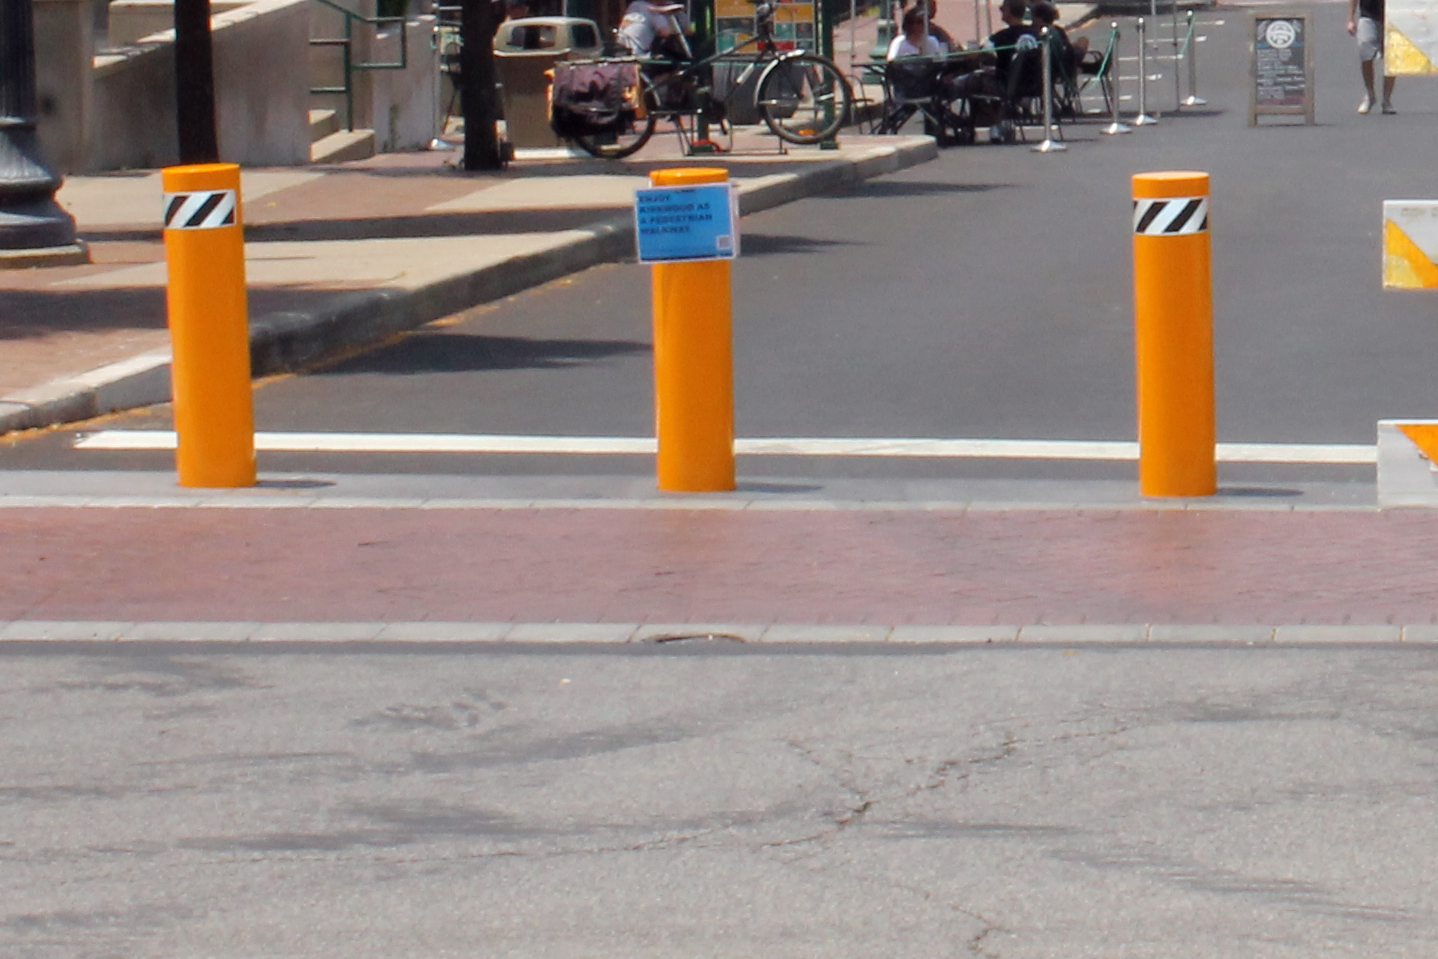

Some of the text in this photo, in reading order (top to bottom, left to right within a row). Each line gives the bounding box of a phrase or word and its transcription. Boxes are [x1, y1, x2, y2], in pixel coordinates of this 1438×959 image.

[639, 194, 670, 203] ENJOY
[697, 202, 711, 211] AS
[641, 213, 713, 225] A PEDESTRIAN
